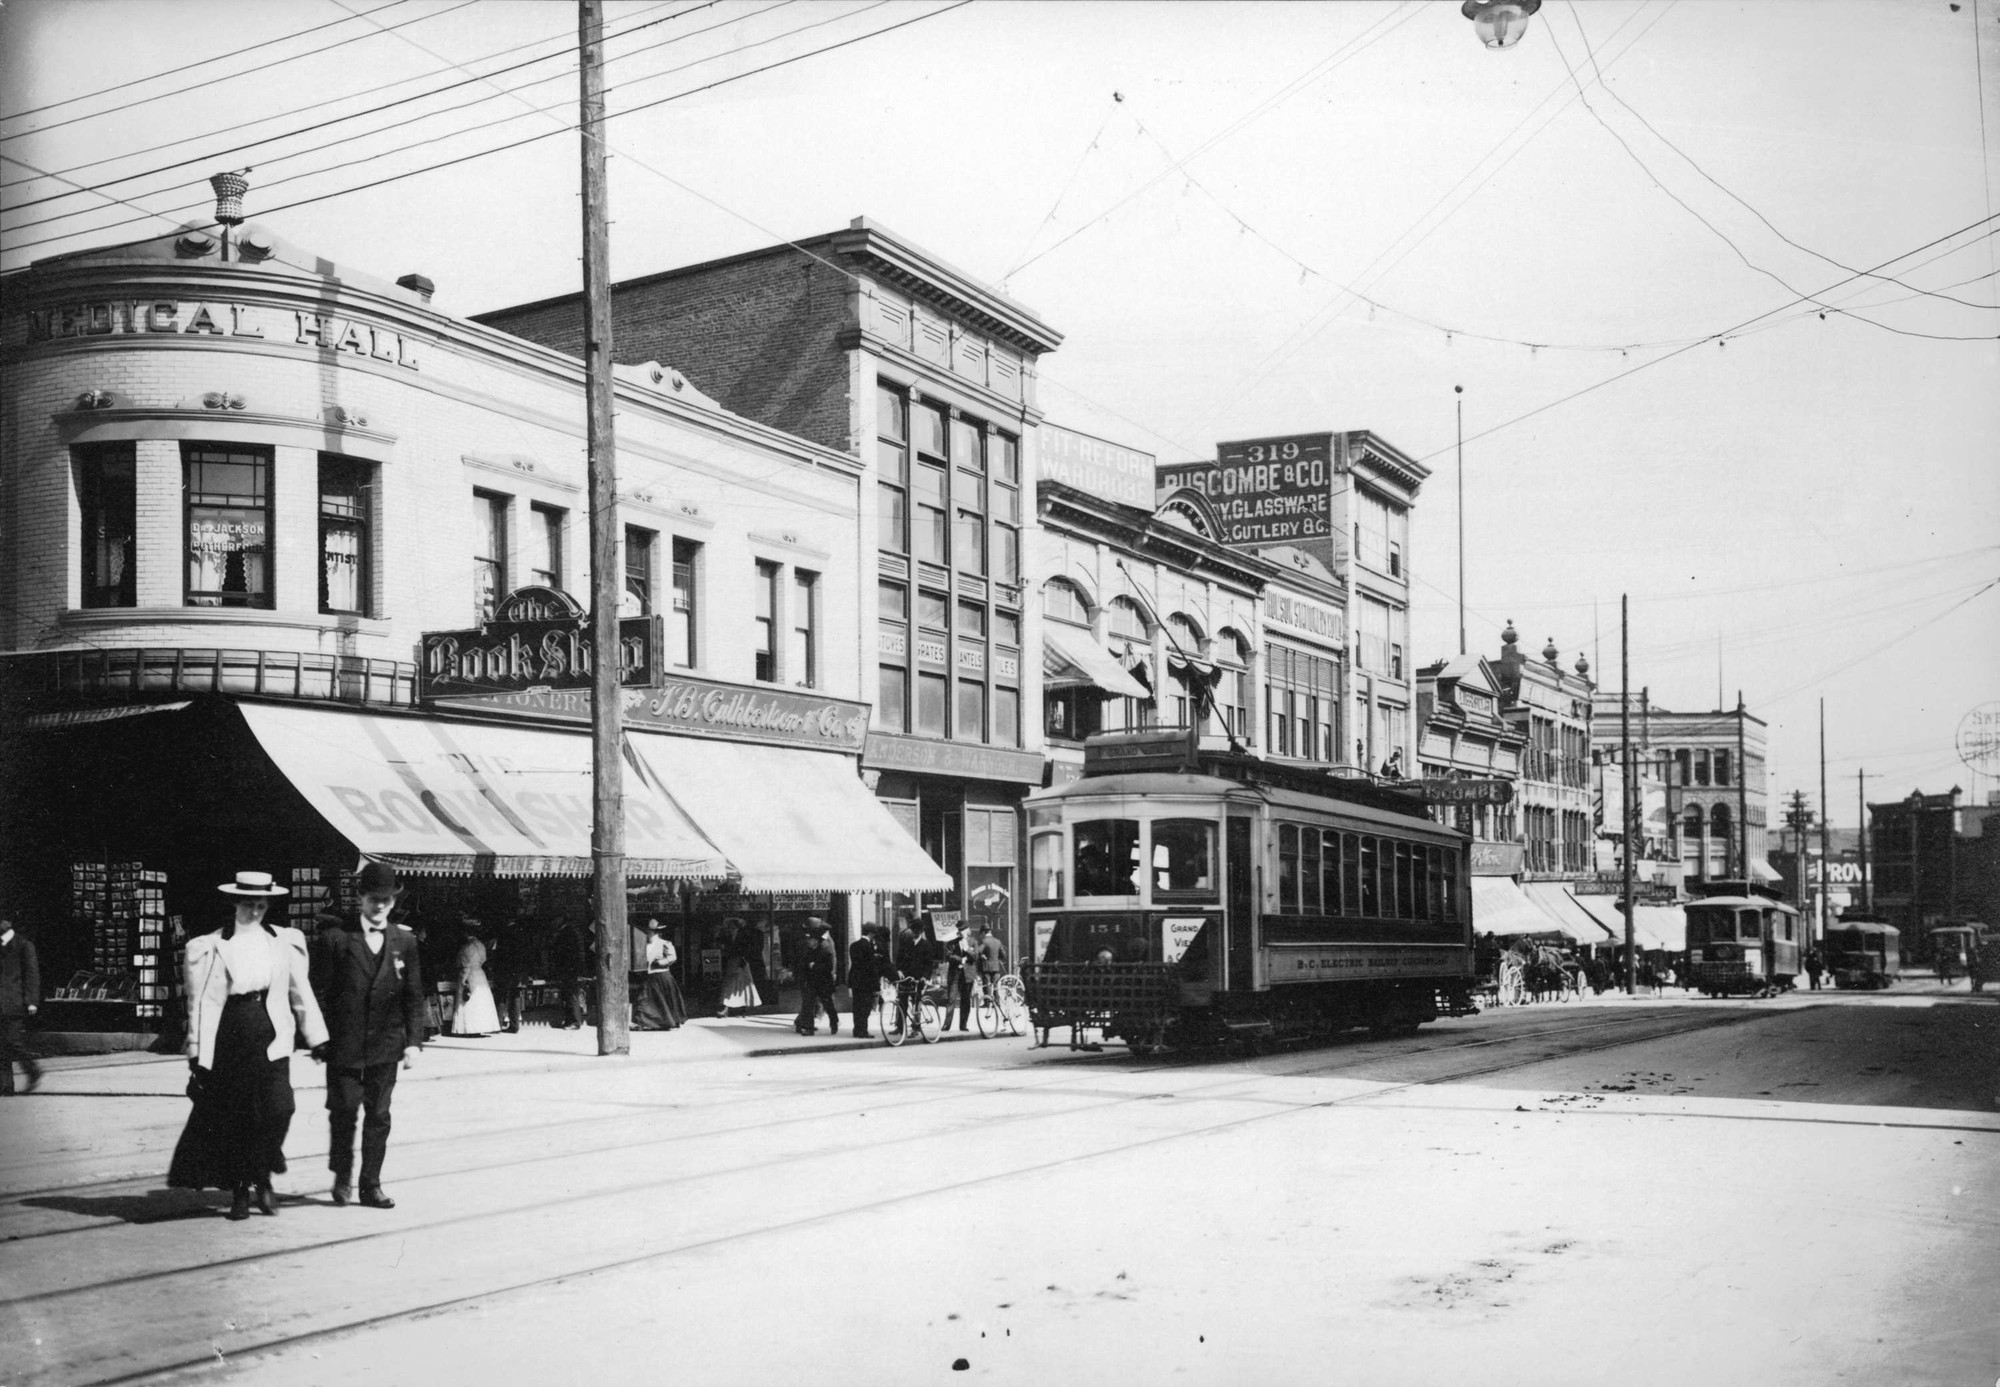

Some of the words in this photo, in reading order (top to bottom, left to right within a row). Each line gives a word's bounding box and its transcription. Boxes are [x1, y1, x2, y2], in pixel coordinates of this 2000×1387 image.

[28, 300, 264, 342] MEDICAL
[295, 311, 420, 371] HALL
[1247, 443, 1300, 463] 319
[1284, 464, 1295, 483] &
[214, 524, 264, 535] JACKSON
[508, 597, 562, 622] The
[428, 633, 535, 688] Book
[539, 629, 644, 682] Shp
[960, 652, 983, 669] ANTELS
[1170, 924, 1200, 934] GRAND
